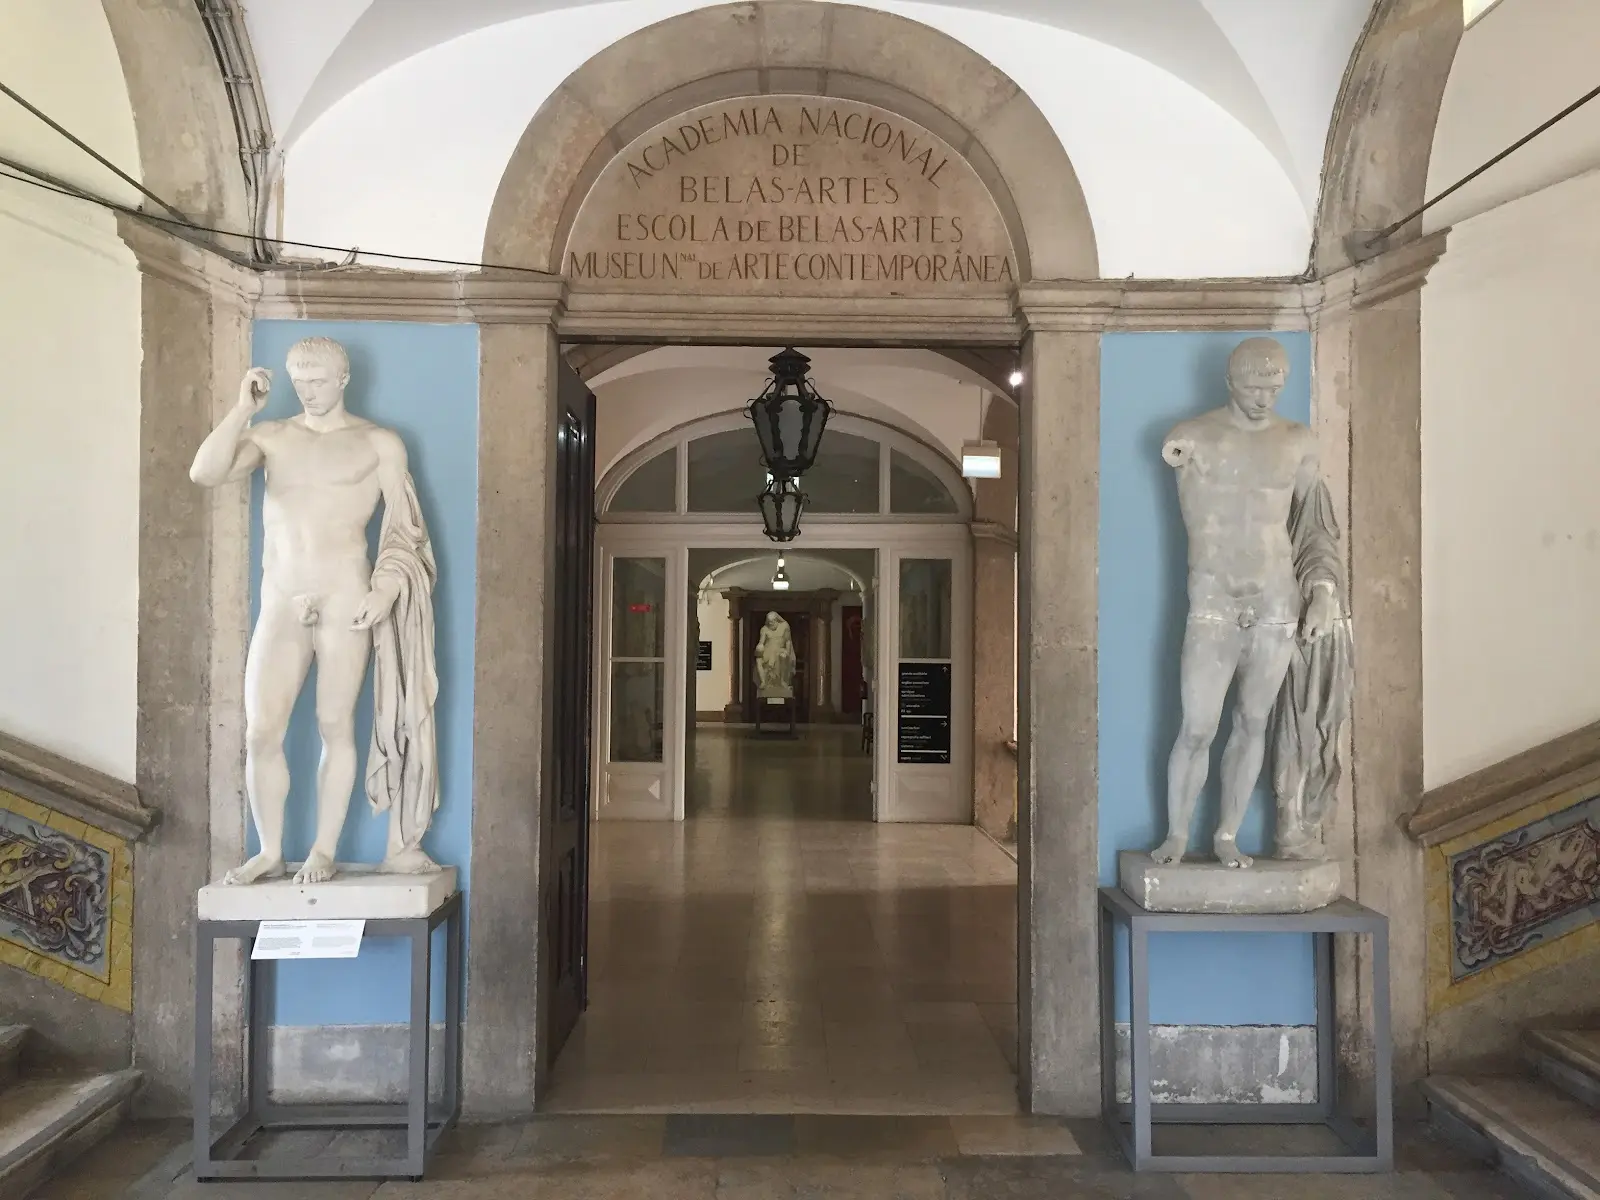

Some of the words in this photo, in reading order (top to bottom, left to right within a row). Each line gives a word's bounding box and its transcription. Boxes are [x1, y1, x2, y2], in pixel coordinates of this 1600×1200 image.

[626, 106, 783, 188] ACADEMIA
[801, 107, 949, 188] NACIONAL
[771, 143, 809, 167] DE
[679, 175, 900, 205] BELAS-ARTES
[617, 213, 730, 242] ESCOLA
[738, 219, 772, 243] DE
[779, 215, 964, 244] BELAS-ARTES
[569, 251, 656, 280] MUSEU
[698, 261, 723, 281] DE
[727, 252, 790, 281] ARTE
[794, 247, 1014, 284] CONTEMPORÂNEA
